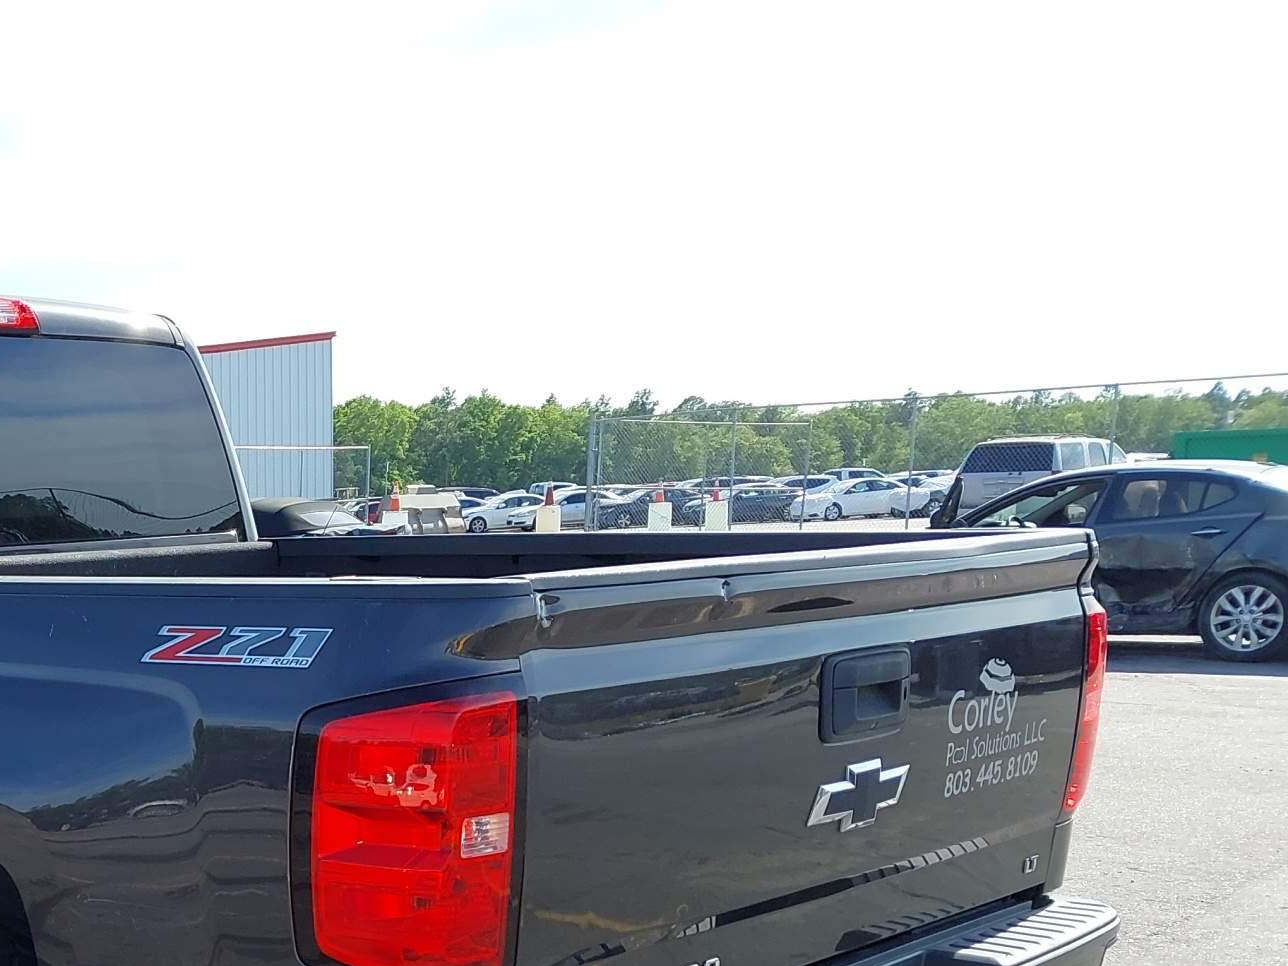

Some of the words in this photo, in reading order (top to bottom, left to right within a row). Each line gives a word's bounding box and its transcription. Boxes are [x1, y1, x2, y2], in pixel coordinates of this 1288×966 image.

[141, 625, 333, 666] Z71
[243, 656, 269, 665] OFF
[271, 657, 310, 667] ROAD
[947, 689, 1019, 734] Corley
[946, 742, 969, 767] Pool
[971, 730, 1022, 760] Solutions
[1024, 718, 1048, 746] LLC
[944, 750, 1039, 798] 803.445.8109
[1024, 854, 1040, 875] LT
